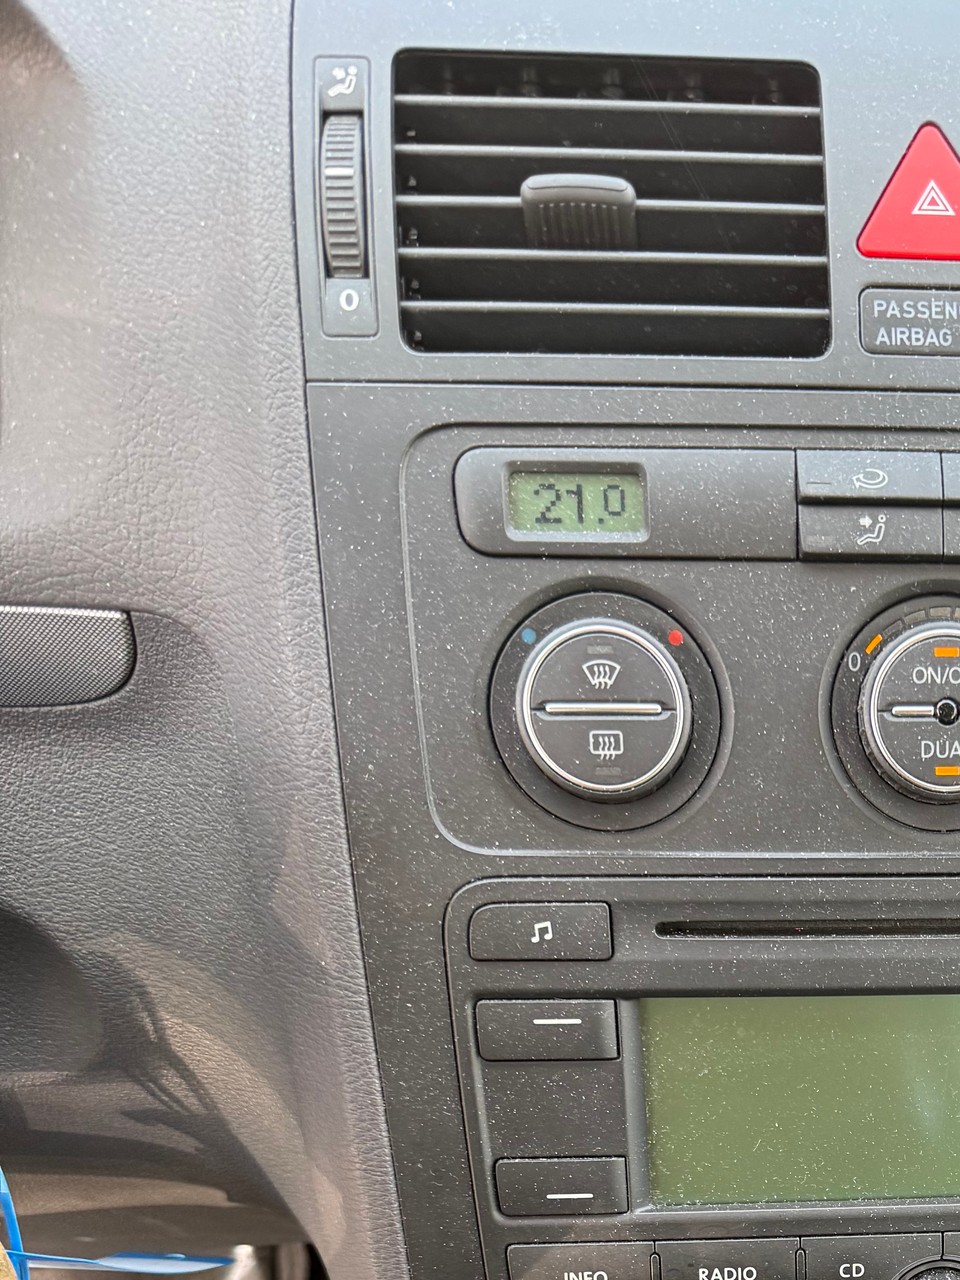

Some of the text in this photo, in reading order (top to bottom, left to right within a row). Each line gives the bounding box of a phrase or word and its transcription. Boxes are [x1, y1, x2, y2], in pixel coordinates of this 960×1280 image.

[339, 289, 359, 311] 0
[875, 327, 952, 347] AIRBAG
[534, 483, 626, 524] 21.0
[848, 651, 861, 672] 0
[838, 1263, 866, 1279] CD
